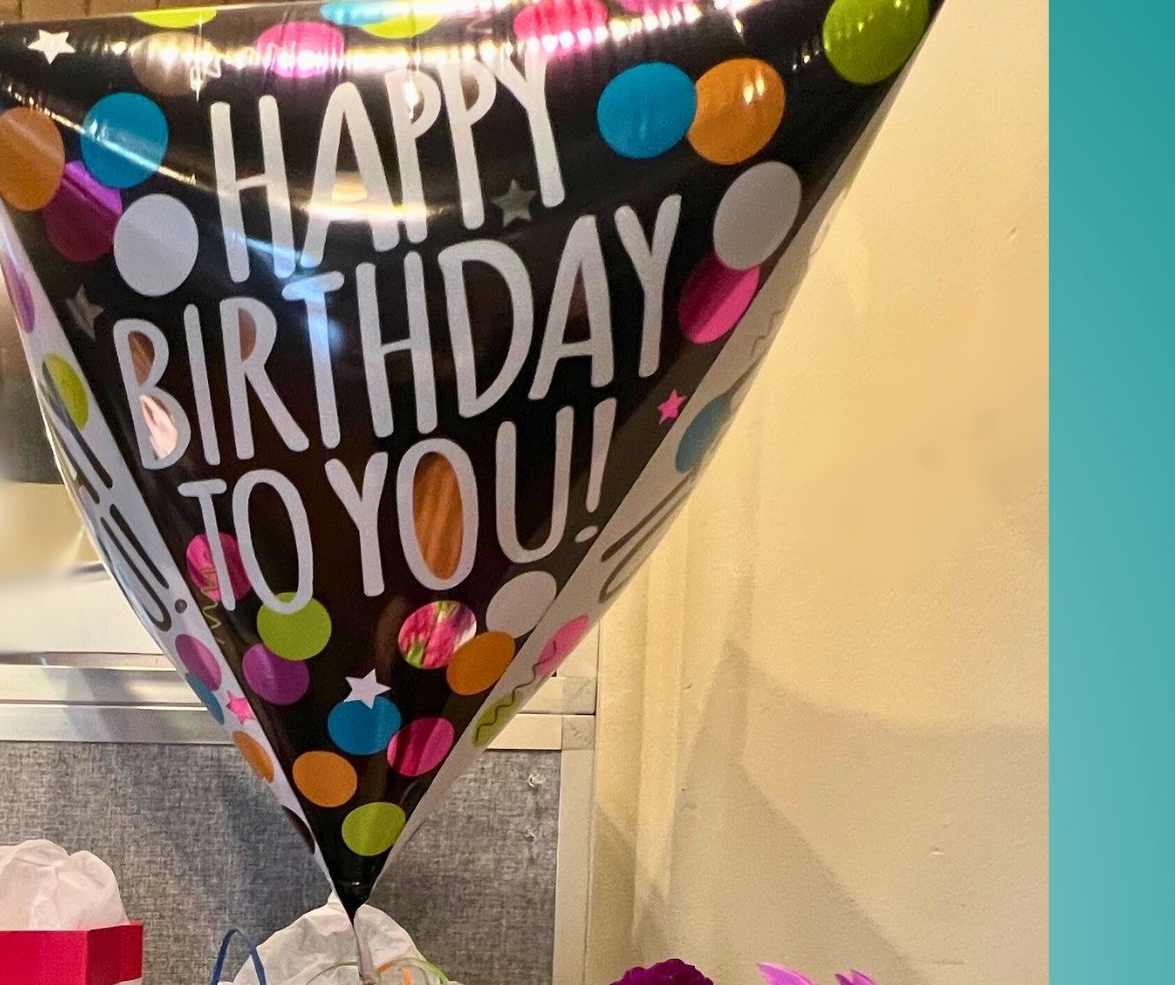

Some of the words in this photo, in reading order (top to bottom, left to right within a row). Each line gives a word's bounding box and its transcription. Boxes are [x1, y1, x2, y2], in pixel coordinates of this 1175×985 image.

[208, 56, 567, 283] HAPPY
[113, 193, 683, 472] BIRTHDAY
[179, 469, 314, 614] TO
[324, 398, 616, 598] YOU!
